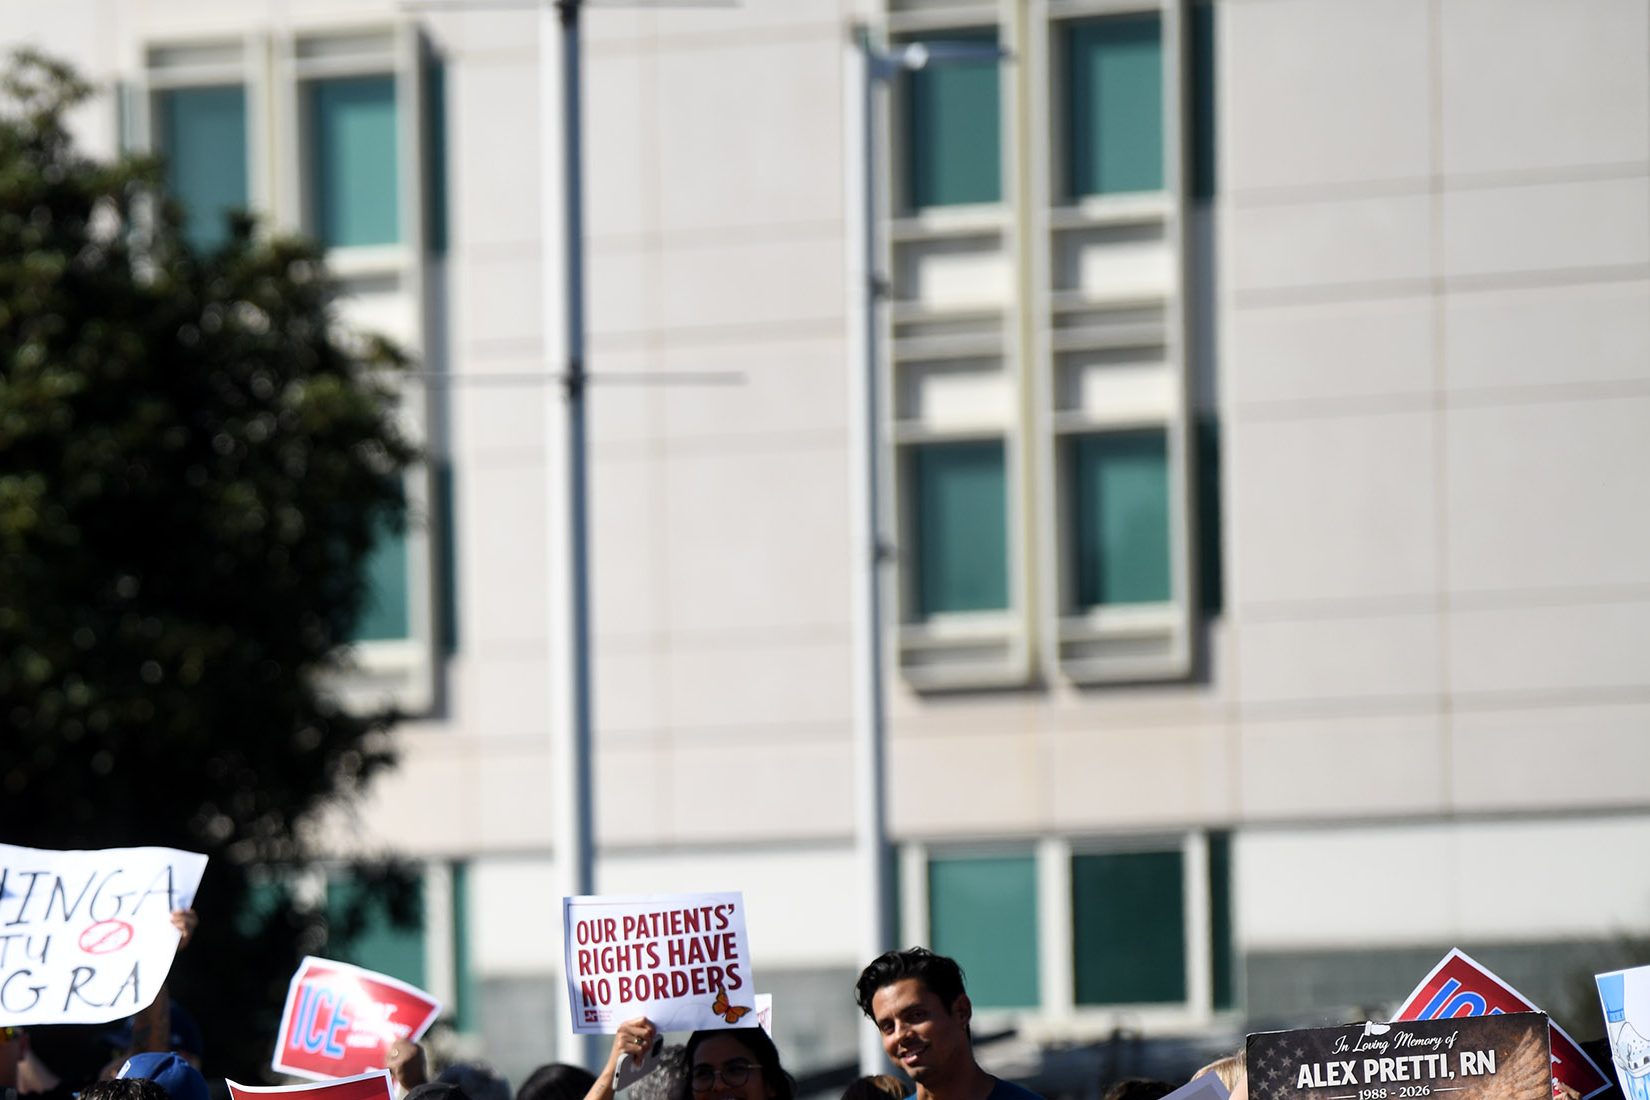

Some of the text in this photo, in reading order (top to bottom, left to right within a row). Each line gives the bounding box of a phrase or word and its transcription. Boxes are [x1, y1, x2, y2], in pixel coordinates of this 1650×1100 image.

[576, 903, 735, 945] OUR PATIENTS'
[578, 932, 739, 976] RIGHTS HAVE
[581, 963, 743, 1008] NO BORDERS
[289, 983, 348, 1060] ICE
[1332, 1030, 1459, 1055] In Loving Memory of
[1296, 1049, 1496, 1089] ALEX PRETTI, RN
[1357, 1088, 1388, 1100] 1988
[1399, 1085, 1431, 1098] 2026
